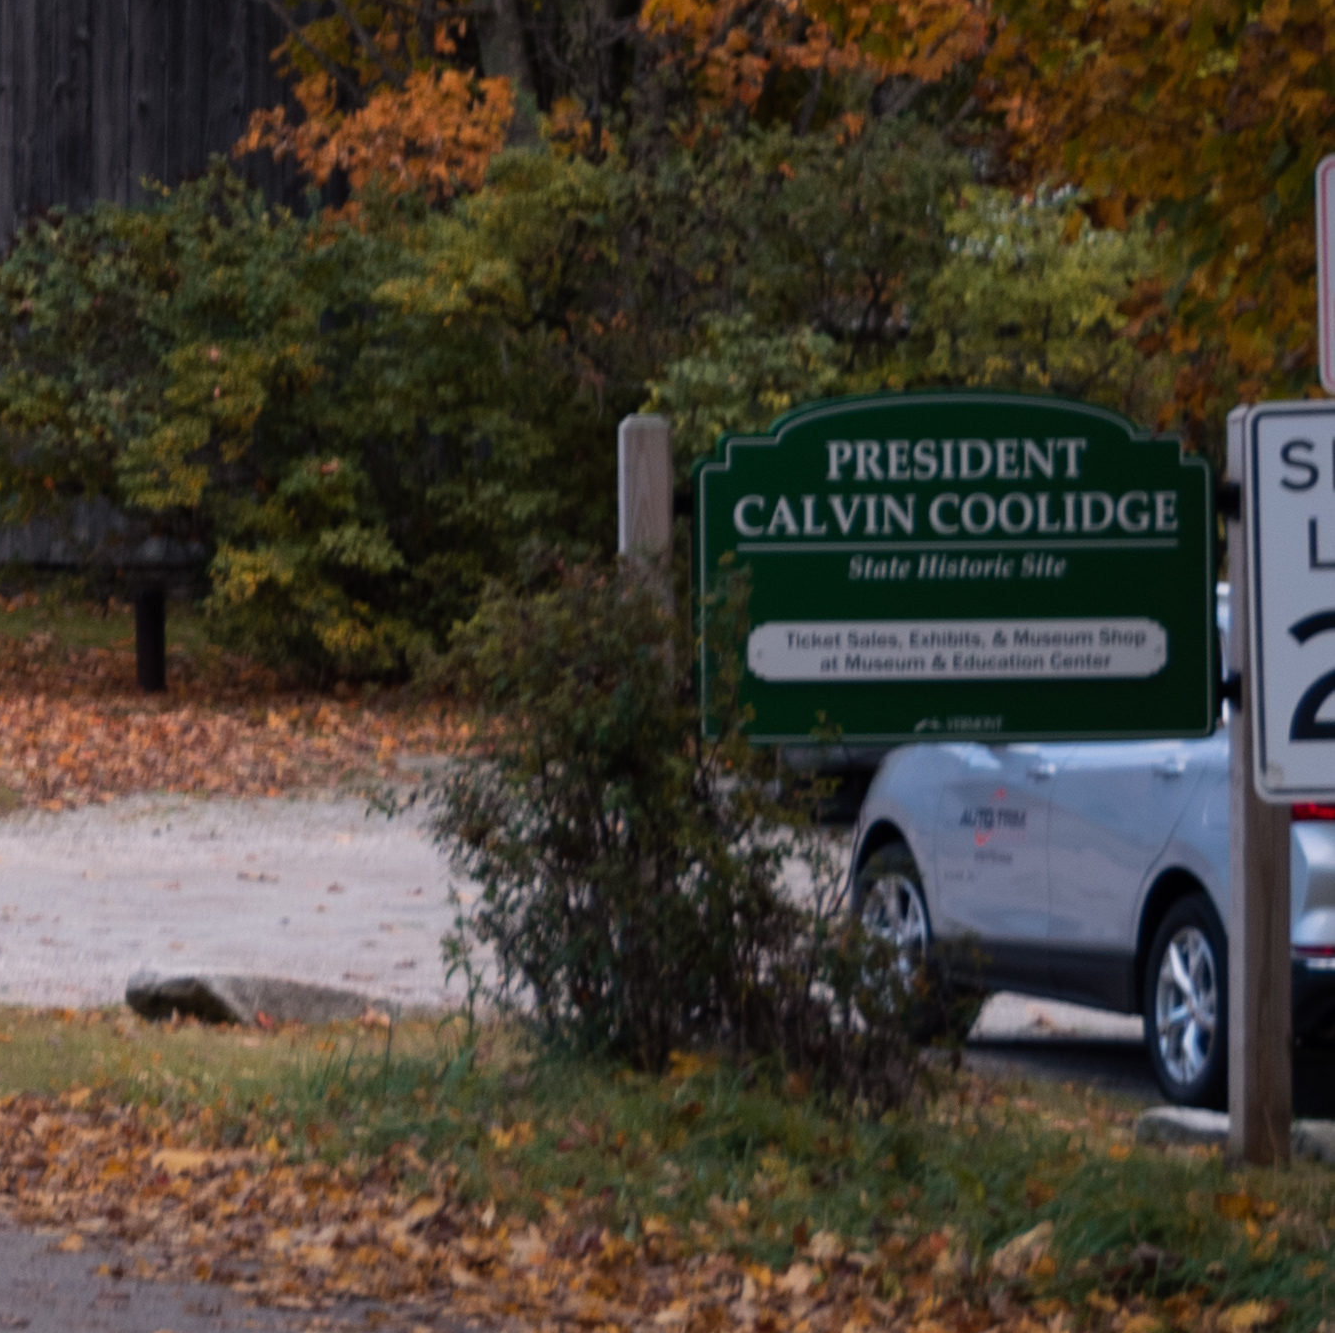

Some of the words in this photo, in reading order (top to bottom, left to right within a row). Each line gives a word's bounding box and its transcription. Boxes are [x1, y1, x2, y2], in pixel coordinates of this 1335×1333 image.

[826, 438, 1087, 481] PRESIDENT
[1280, 437, 1335, 494] S
[733, 493, 915, 536] CALVIN
[928, 490, 1178, 534] COOLIDGE
[849, 554, 911, 580] State
[918, 552, 1015, 579] Historic
[1021, 551, 1068, 579] Site
[787, 629, 841, 649] Ticket
[847, 629, 903, 651] Sales,
[909, 628, 985, 650] Exhibits,
[992, 629, 1007, 647] &
[1013, 628, 1093, 647] Museum
[1099, 627, 1148, 649] Shop
[820, 654, 838, 672] at
[845, 653, 926, 671] Museum
[931, 653, 946, 671] &
[952, 651, 1044, 670] Education
[1050, 651, 1111, 669] Center
